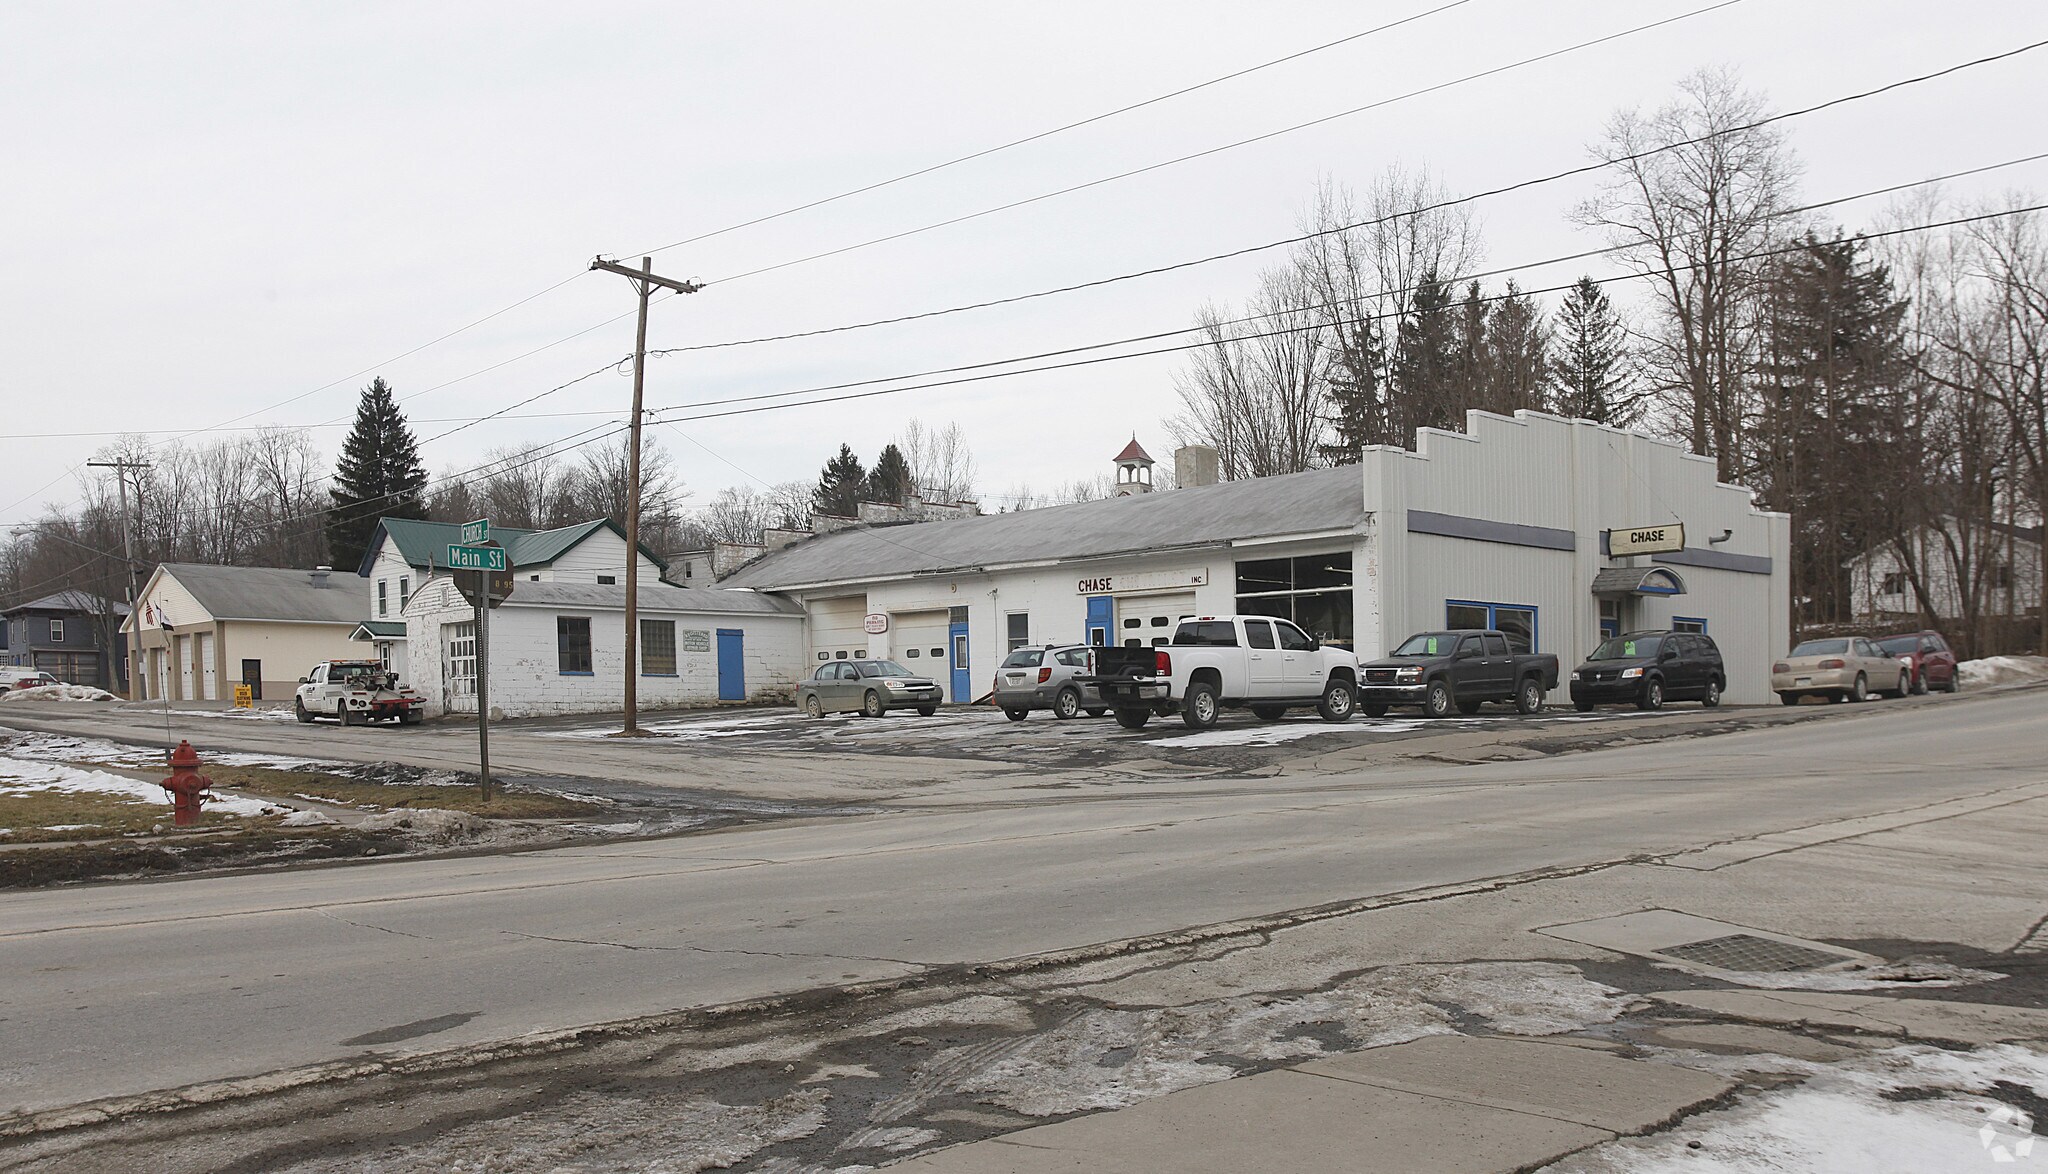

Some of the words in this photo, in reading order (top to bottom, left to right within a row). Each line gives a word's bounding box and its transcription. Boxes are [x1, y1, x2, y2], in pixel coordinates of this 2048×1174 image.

[463, 524, 482, 543] CHURCH
[1631, 530, 1664, 543] CHASE
[451, 548, 480, 566] Main
[489, 551, 502, 568] St
[1078, 578, 1112, 592] CHASE
